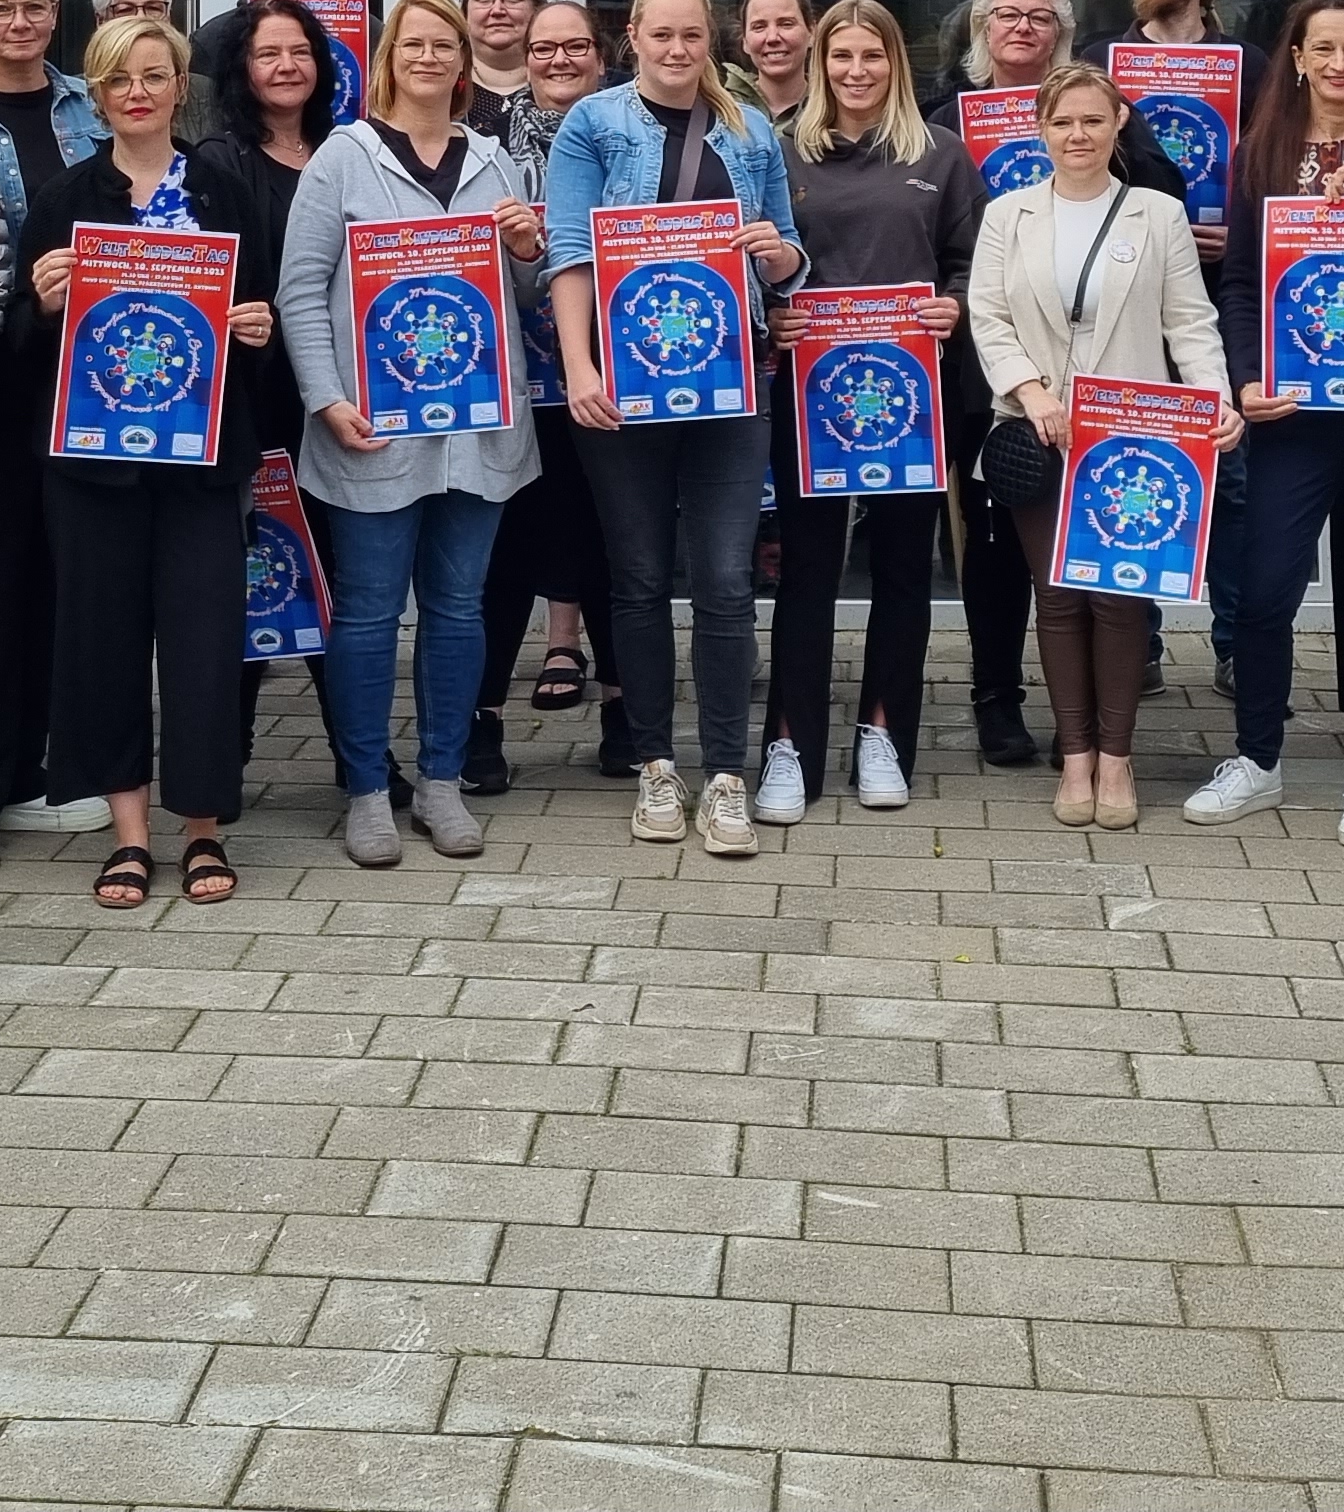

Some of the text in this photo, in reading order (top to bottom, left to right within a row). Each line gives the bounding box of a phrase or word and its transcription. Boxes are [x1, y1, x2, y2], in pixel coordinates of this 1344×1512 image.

[665, 232, 712, 242] SEPTEMBER
[423, 245, 469, 256] SEPTEMBER
[150, 263, 202, 274] SEPTEMBER
[861, 314, 906, 323] SEPTEMBER
[1142, 411, 1189, 423] SEPTEMBER
